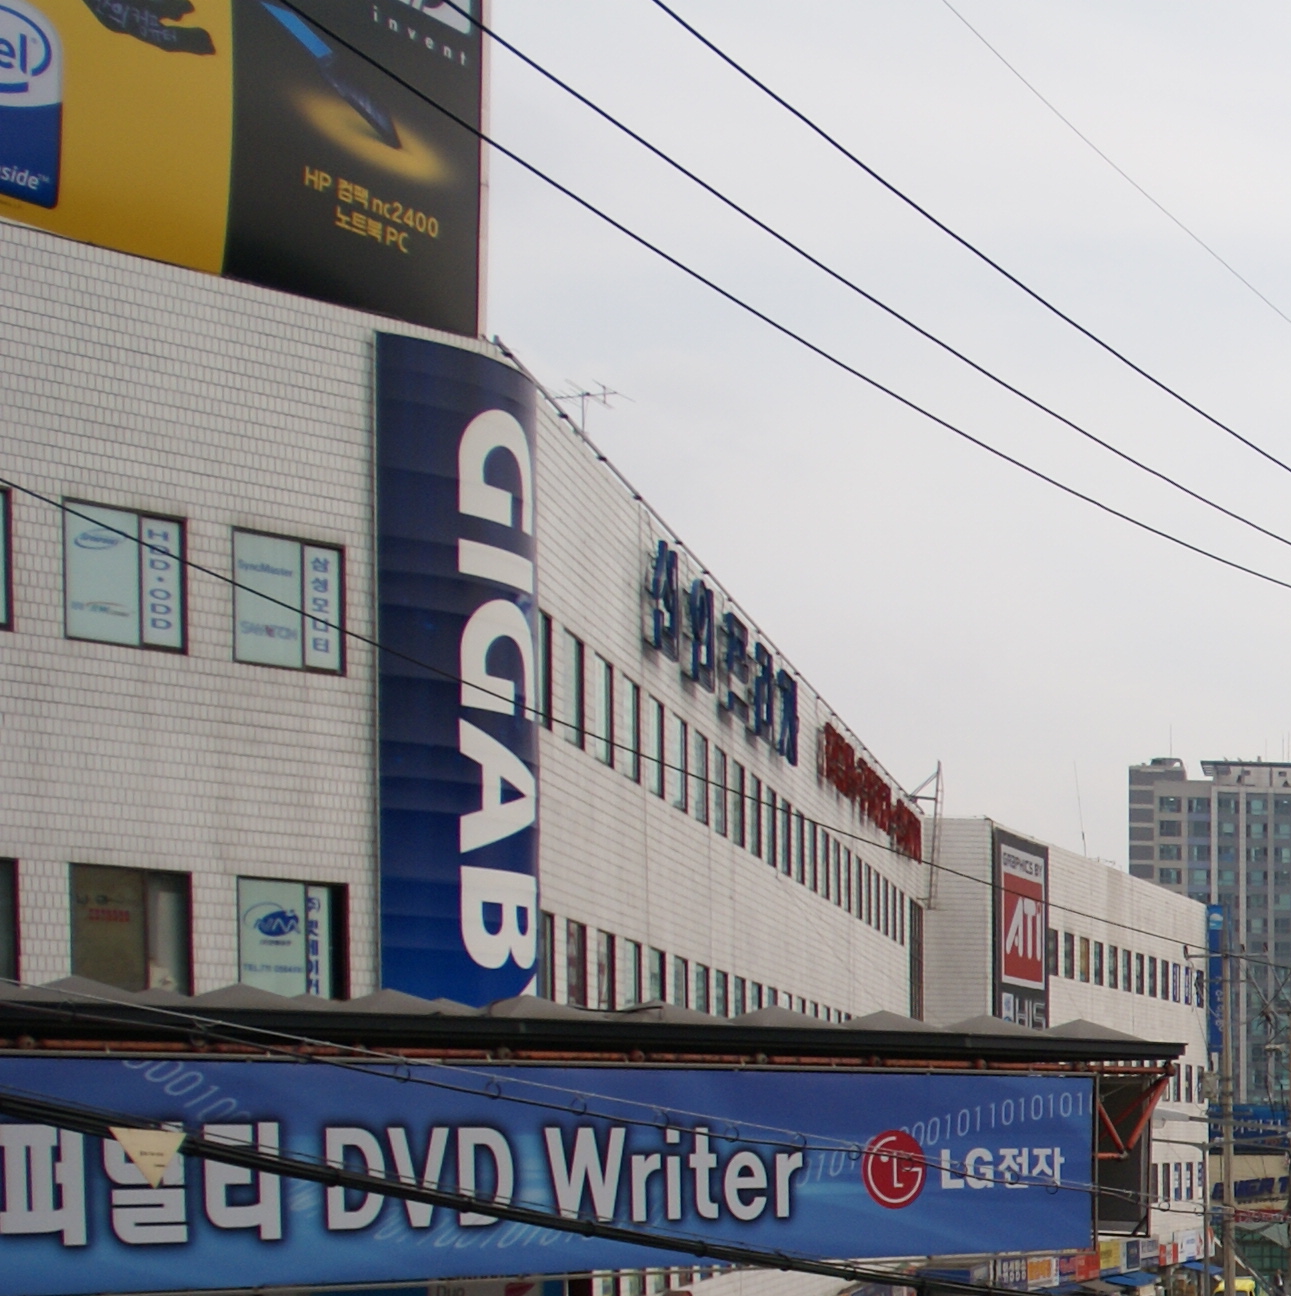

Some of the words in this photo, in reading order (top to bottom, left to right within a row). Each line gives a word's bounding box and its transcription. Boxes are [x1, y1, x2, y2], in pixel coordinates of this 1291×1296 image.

[372, 5, 467, 66] invent
[0, 164, 40, 190] side
[304, 166, 332, 191] HP
[338, 177, 369, 210] 컴팩
[371, 196, 439, 239] nc2400
[335, 207, 383, 241] 노트북
[385, 227, 409, 253] PC
[457, 408, 540, 996] GIGAB
[1034, 862, 1043, 877] BY
[323, 1123, 510, 1232] DVD
[545, 1123, 805, 1223] Writer
[940, 1144, 1067, 1192] LG전자
